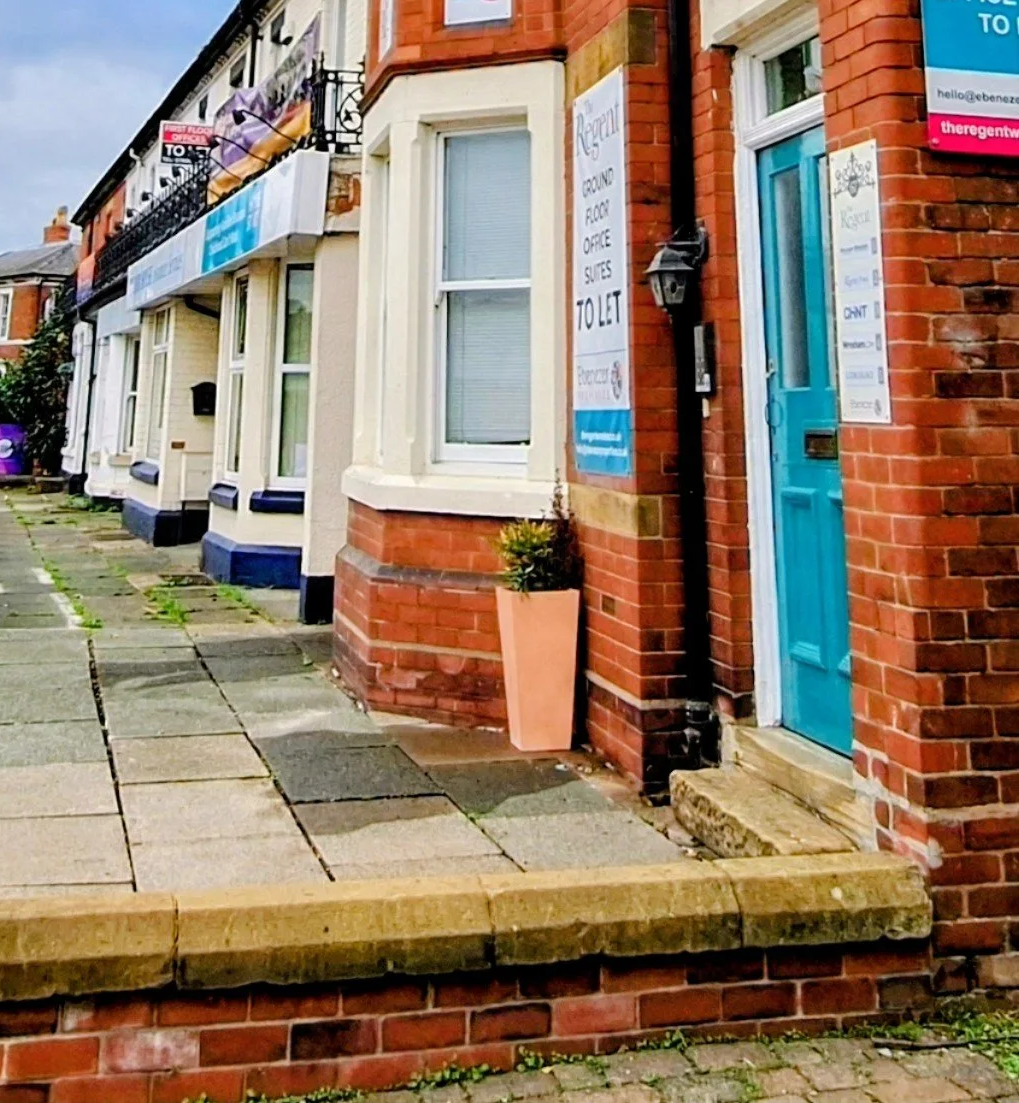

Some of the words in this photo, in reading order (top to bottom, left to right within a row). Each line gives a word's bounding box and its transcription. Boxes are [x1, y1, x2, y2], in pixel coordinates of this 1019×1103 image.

[977, 12, 1010, 35] TO
[576, 103, 620, 161] Regent
[164, 144, 186, 157] TO
[582, 167, 614, 198] GROUND
[585, 199, 610, 226] FLOOR
[583, 229, 612, 255] OFFICE
[584, 259, 612, 285] SUITES
[576, 297, 594, 331] TO
[598, 289, 622, 328] LET
